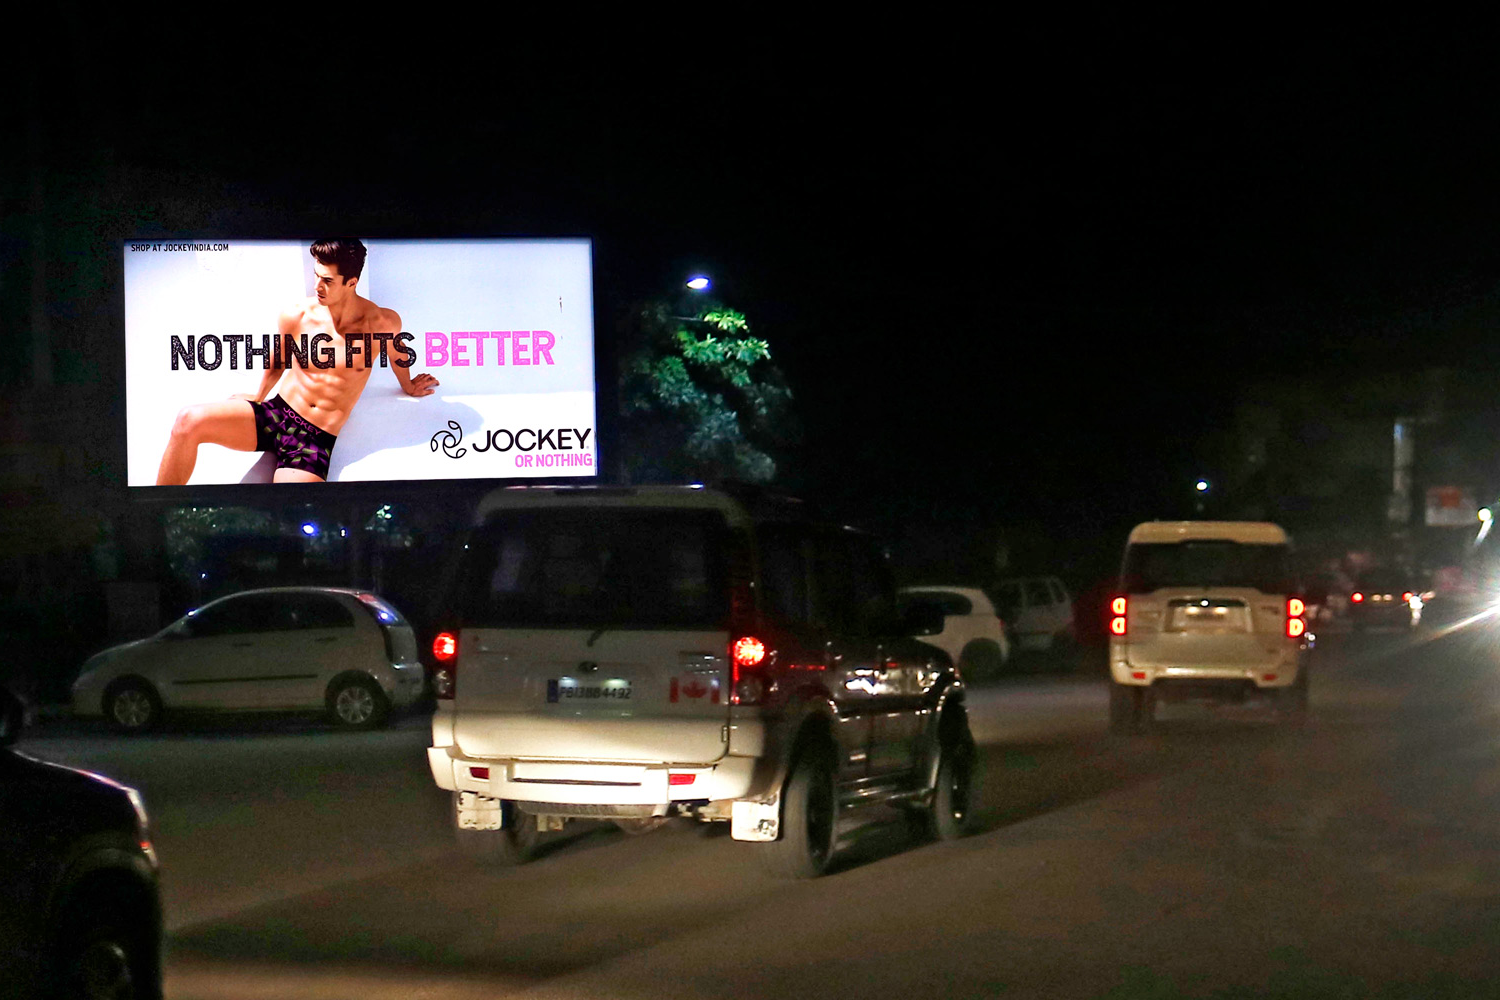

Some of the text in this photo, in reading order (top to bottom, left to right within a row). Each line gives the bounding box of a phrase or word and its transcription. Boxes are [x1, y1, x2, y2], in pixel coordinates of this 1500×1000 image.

[130, 243, 229, 252] SHOP AT JOCKEYINDIA.COM
[171, 330, 556, 371] NOTHING FITS BETTER
[283, 407, 321, 435] JOCKEY
[472, 427, 591, 452] JOCKEY
[515, 453, 592, 467] OR NOTHING
